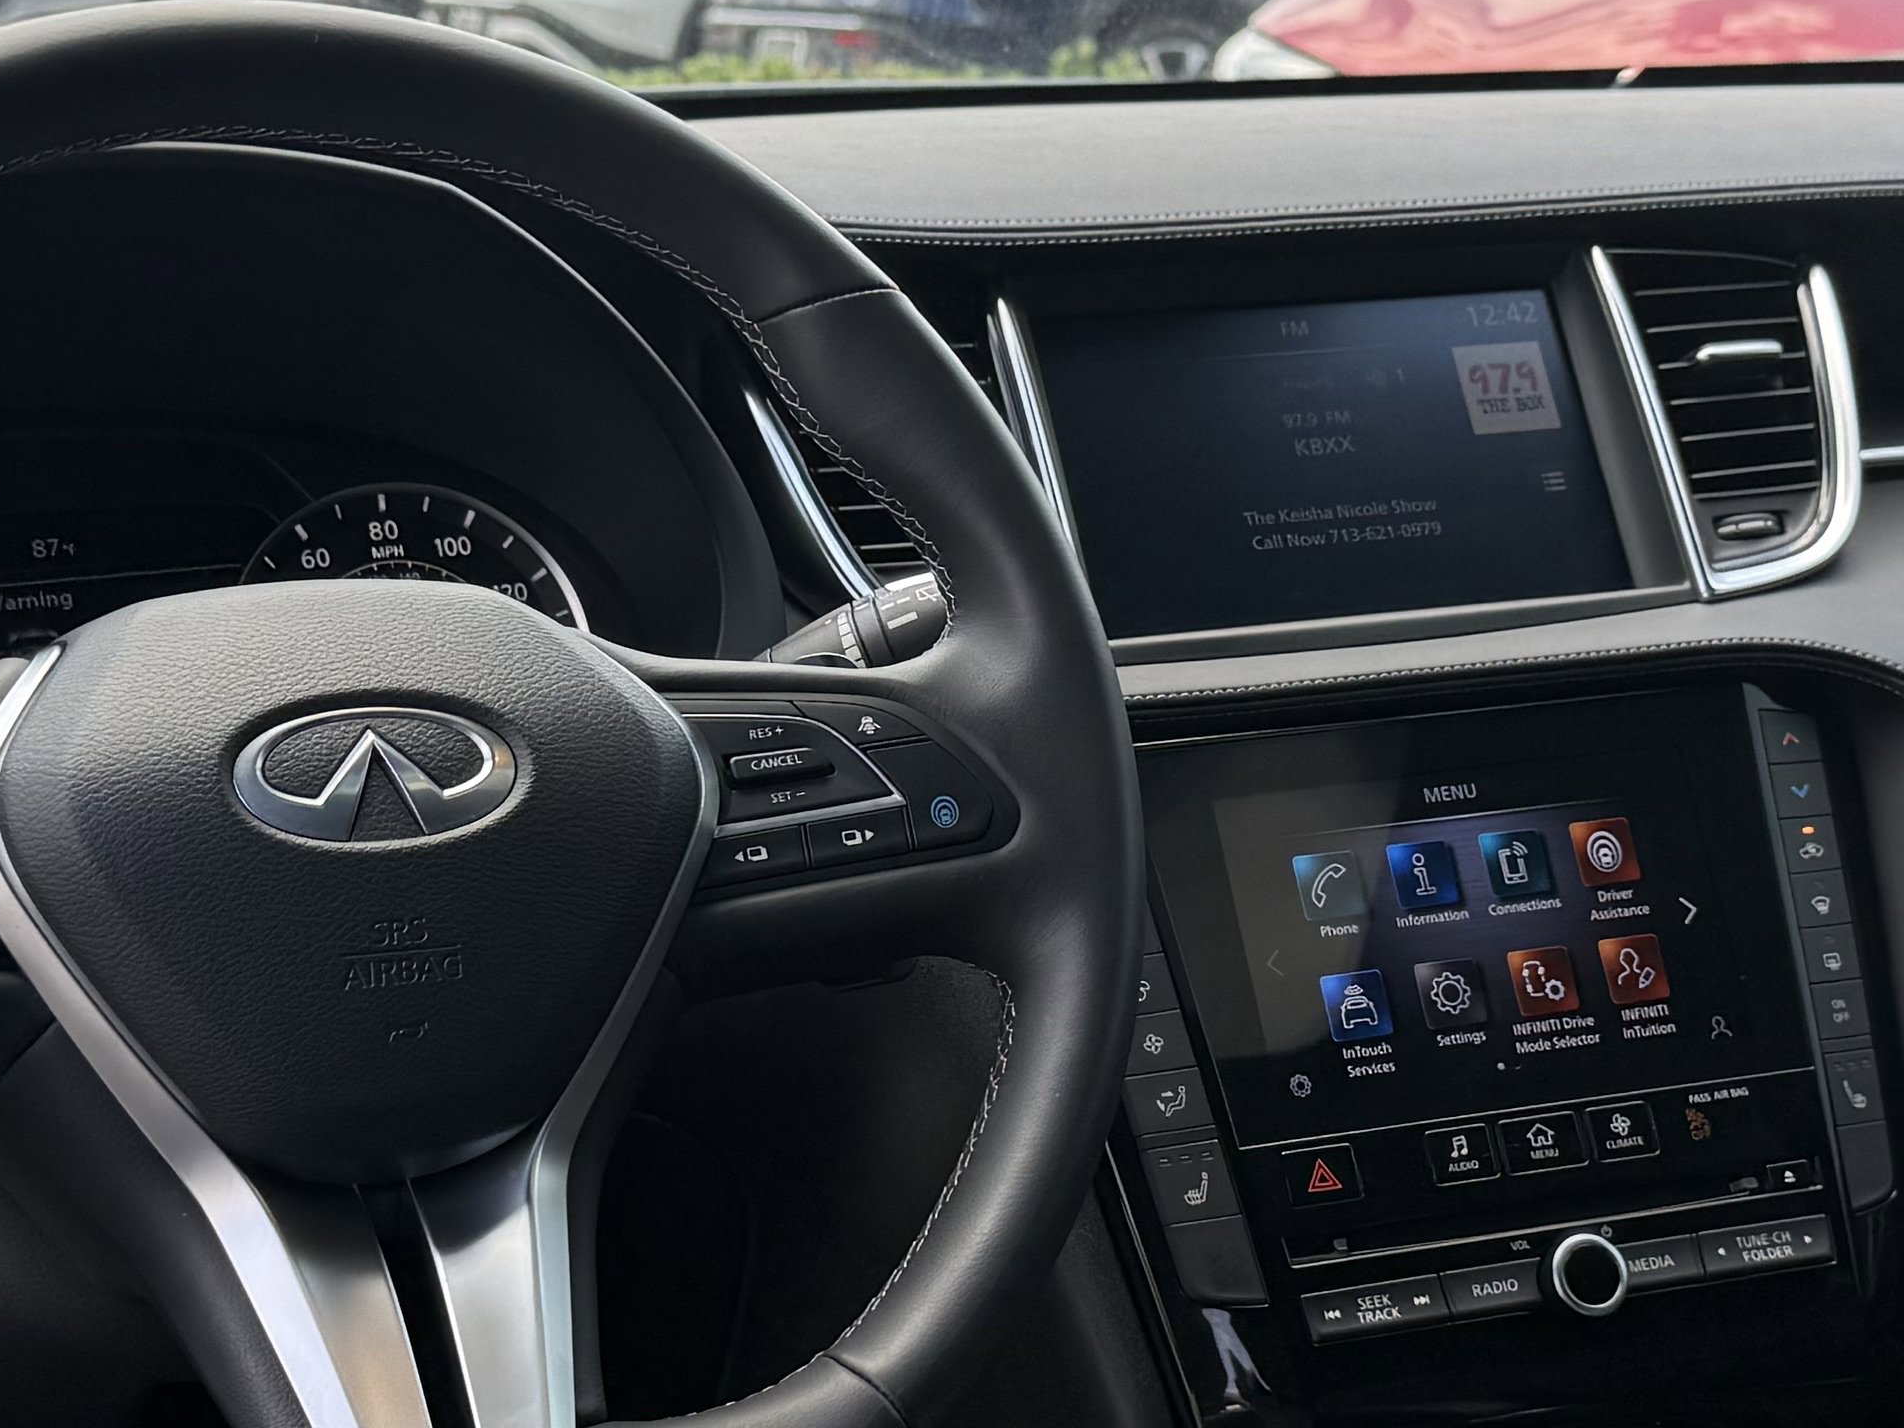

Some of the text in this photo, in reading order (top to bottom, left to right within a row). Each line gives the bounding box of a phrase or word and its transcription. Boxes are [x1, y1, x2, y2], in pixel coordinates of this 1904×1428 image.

[1466, 301, 1537, 328] 12:42
[1468, 361, 1540, 394] 97.9
[1477, 392, 1546, 414] THE BOX
[1294, 435, 1355, 457] KBXX
[1243, 498, 1437, 527] The Keisha Nicole Show
[368, 519, 399, 541] 80
[433, 535, 472, 558] 100
[1252, 534, 1284, 550] Call
[1287, 531, 1327, 548] Now
[300, 547, 331, 569] 60
[371, 543, 405, 560] MPH
[748, 727, 773, 740] RES
[751, 754, 804, 771] CANCEL
[770, 791, 792, 804] SET
[1422, 782, 1477, 804] MENU
[1597, 888, 1634, 904] Driver
[1487, 896, 1562, 917] Connections
[1590, 903, 1650, 922] Assistance
[1396, 909, 1470, 928] Information
[374, 918, 428, 946] SRS
[1319, 922, 1359, 938] Phone
[343, 955, 463, 991] AIRBAG
[1620, 1004, 1670, 1022] INFINITI
[1511, 1015, 1596, 1036] INFINITI Drive
[1623, 1021, 1677, 1040] InTuition
[1435, 1031, 1488, 1049] Settings
[1516, 1032, 1601, 1054] Mode Selector
[1341, 1042, 1393, 1060] InTouch
[1346, 1061, 1396, 1078] Services
[1606, 1135, 1645, 1150] CLIMATE
[1448, 1158, 1480, 1173] AUDIO
[1510, 1238, 1532, 1251] VOL
[1741, 1245, 1795, 1263] FOLDER
[1628, 1253, 1676, 1273] MEDIA
[1471, 1277, 1519, 1299] RADIO
[1356, 1294, 1393, 1310] SEEK
[1356, 1306, 1403, 1325] TRACK
